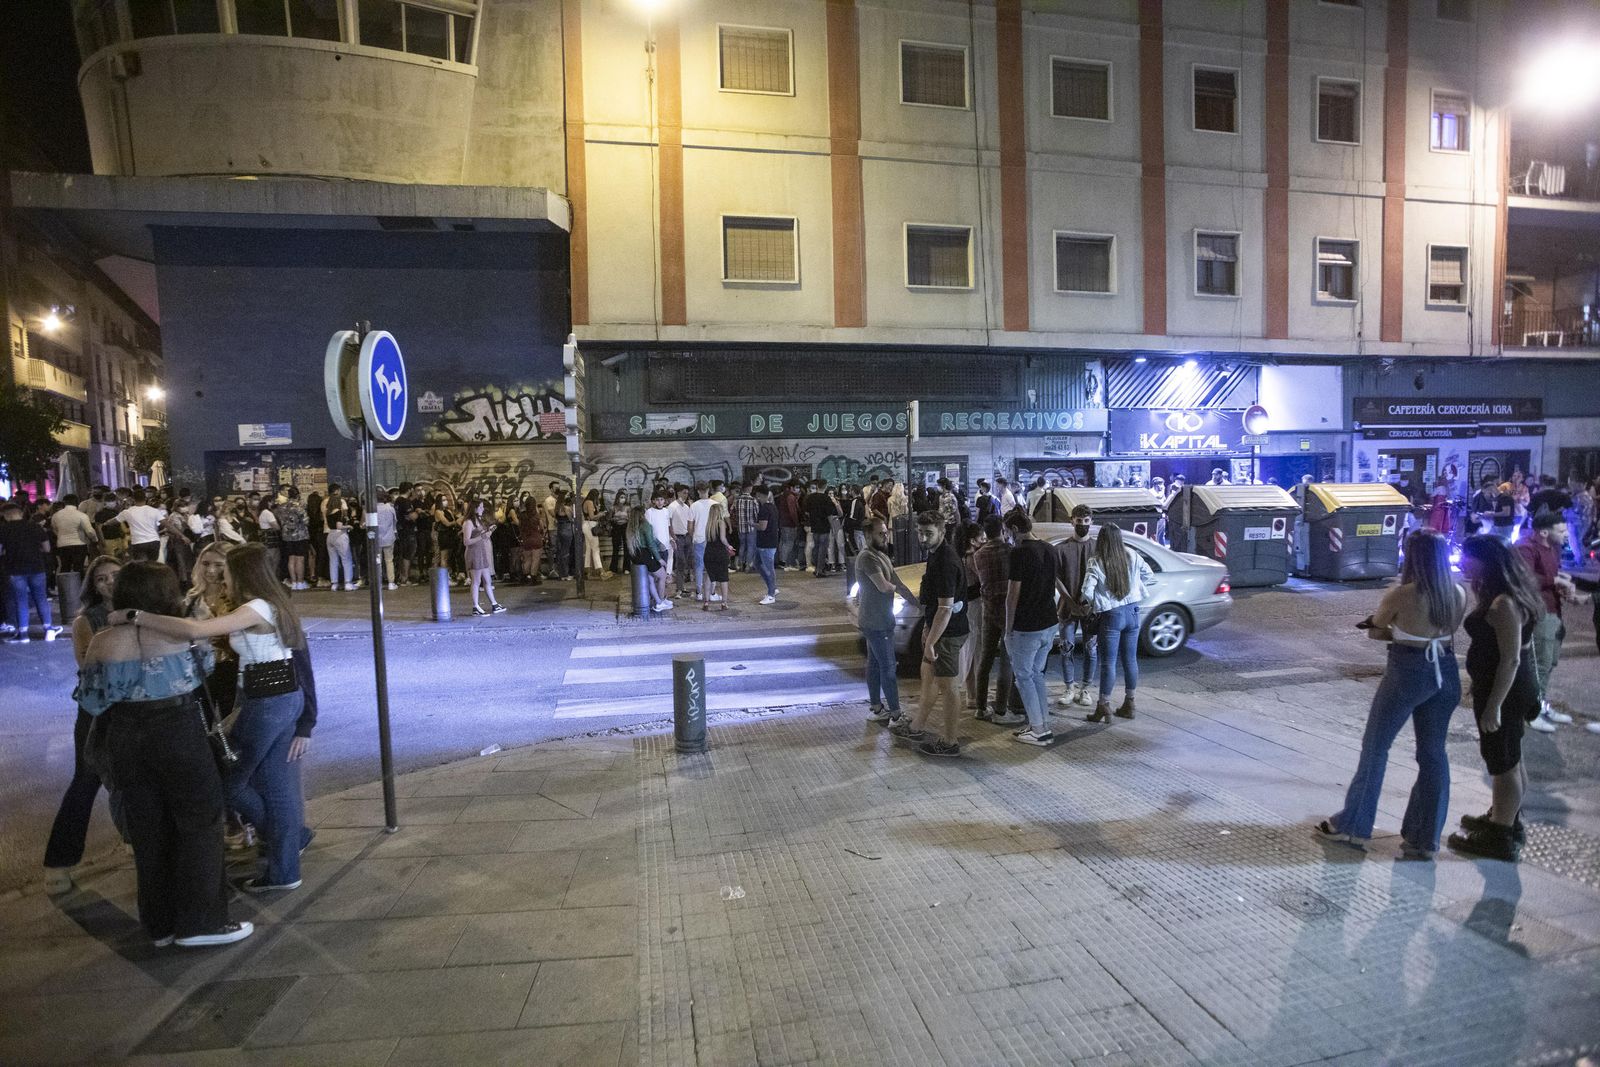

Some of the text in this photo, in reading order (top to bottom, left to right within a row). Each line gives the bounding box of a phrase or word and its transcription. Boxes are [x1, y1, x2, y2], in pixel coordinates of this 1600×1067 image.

[1388, 403, 1436, 415] CAFETERÍA
[1437, 403, 1490, 415] CERVECERÍA
[750, 414, 784, 433] DE
[807, 413, 907, 432] JUEGOS
[941, 412, 1084, 431] RECREATIVOS
[1143, 433, 1228, 449] KAPITAL
